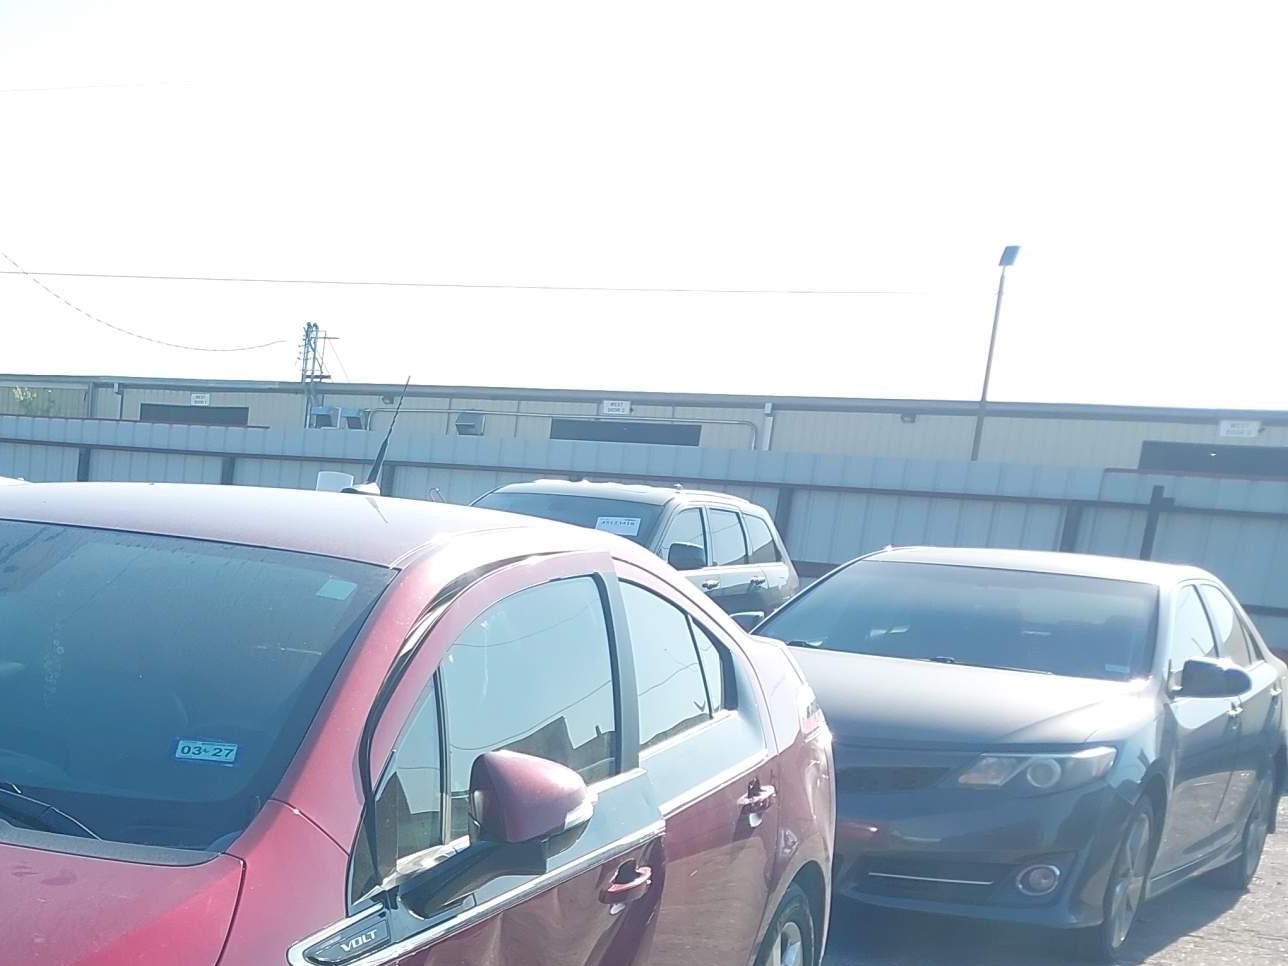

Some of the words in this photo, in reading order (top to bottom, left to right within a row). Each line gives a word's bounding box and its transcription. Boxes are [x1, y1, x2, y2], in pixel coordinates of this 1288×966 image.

[181, 746, 202, 755] 03
[212, 748, 234, 758] 27
[340, 929, 377, 952] VOLT
